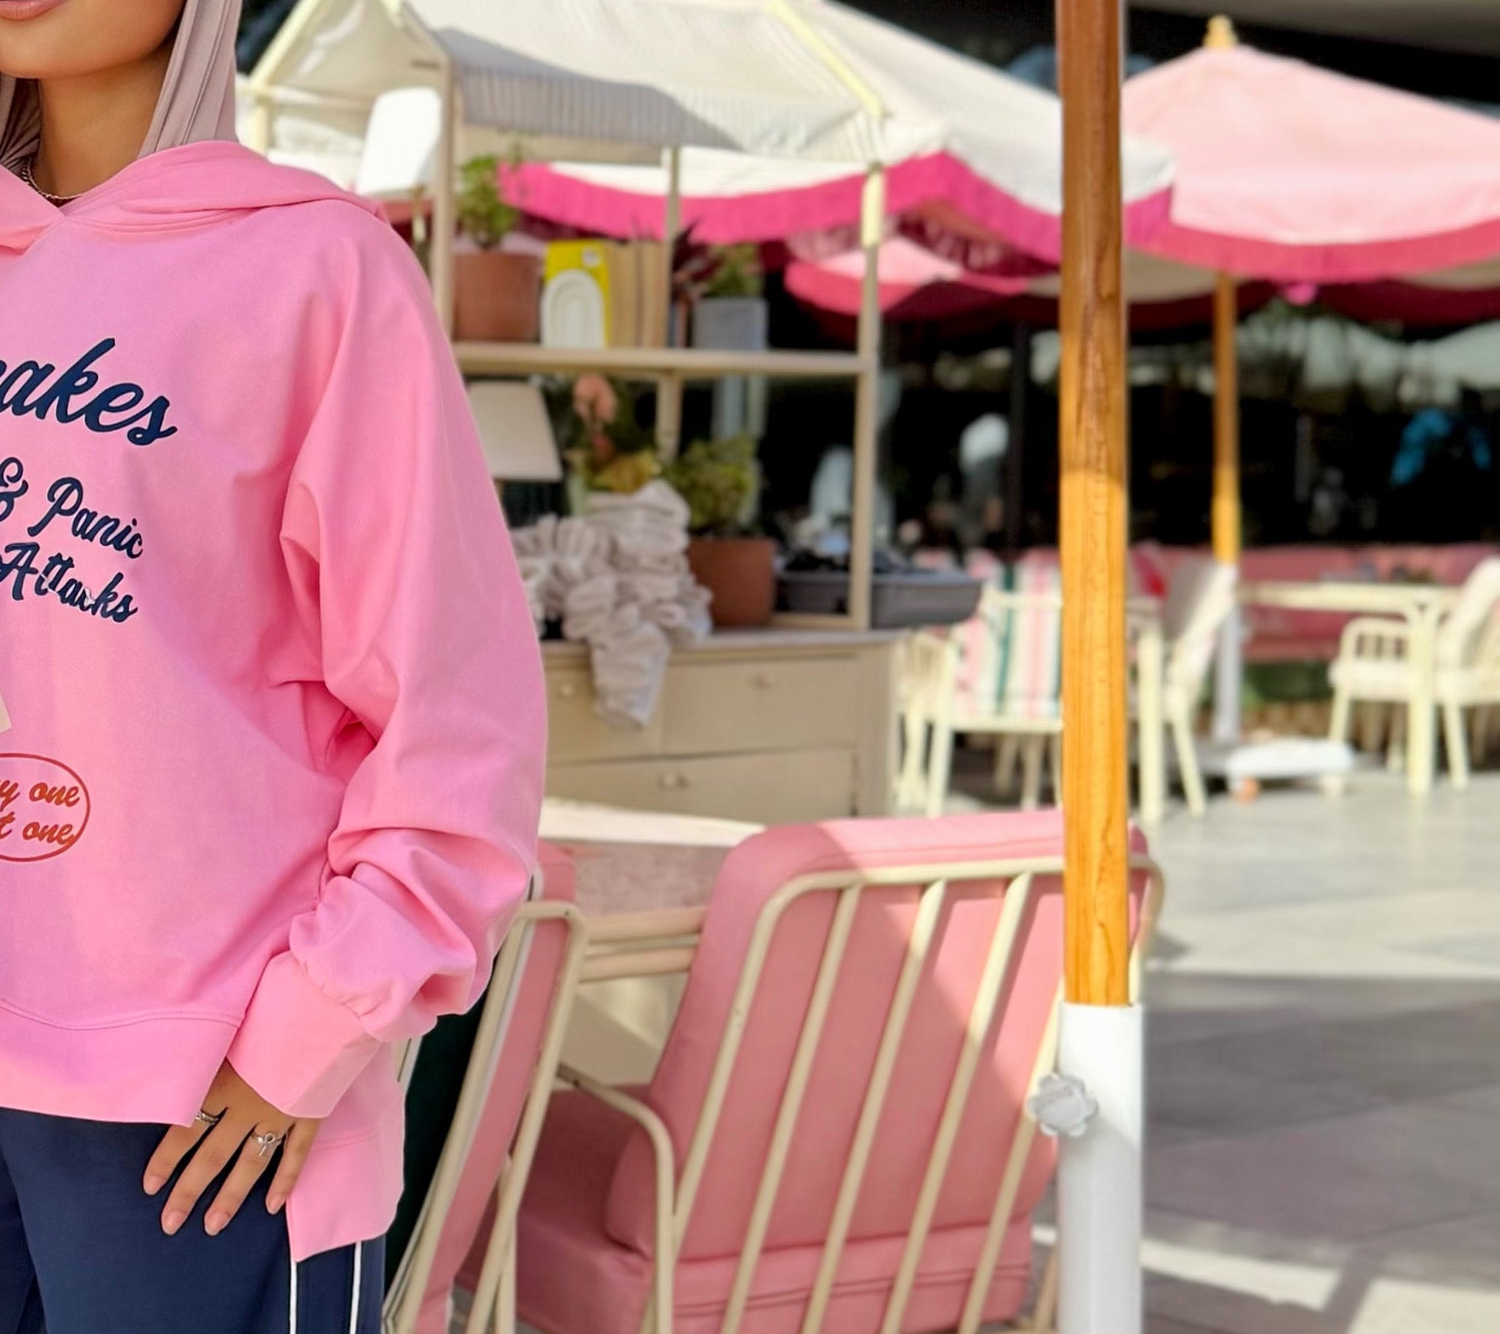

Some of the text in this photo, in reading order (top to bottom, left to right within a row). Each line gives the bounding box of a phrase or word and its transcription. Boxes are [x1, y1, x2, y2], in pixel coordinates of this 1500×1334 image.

[27, 477, 143, 559] Panic
[29, 782, 80, 807] one
[22, 822, 76, 845] one
